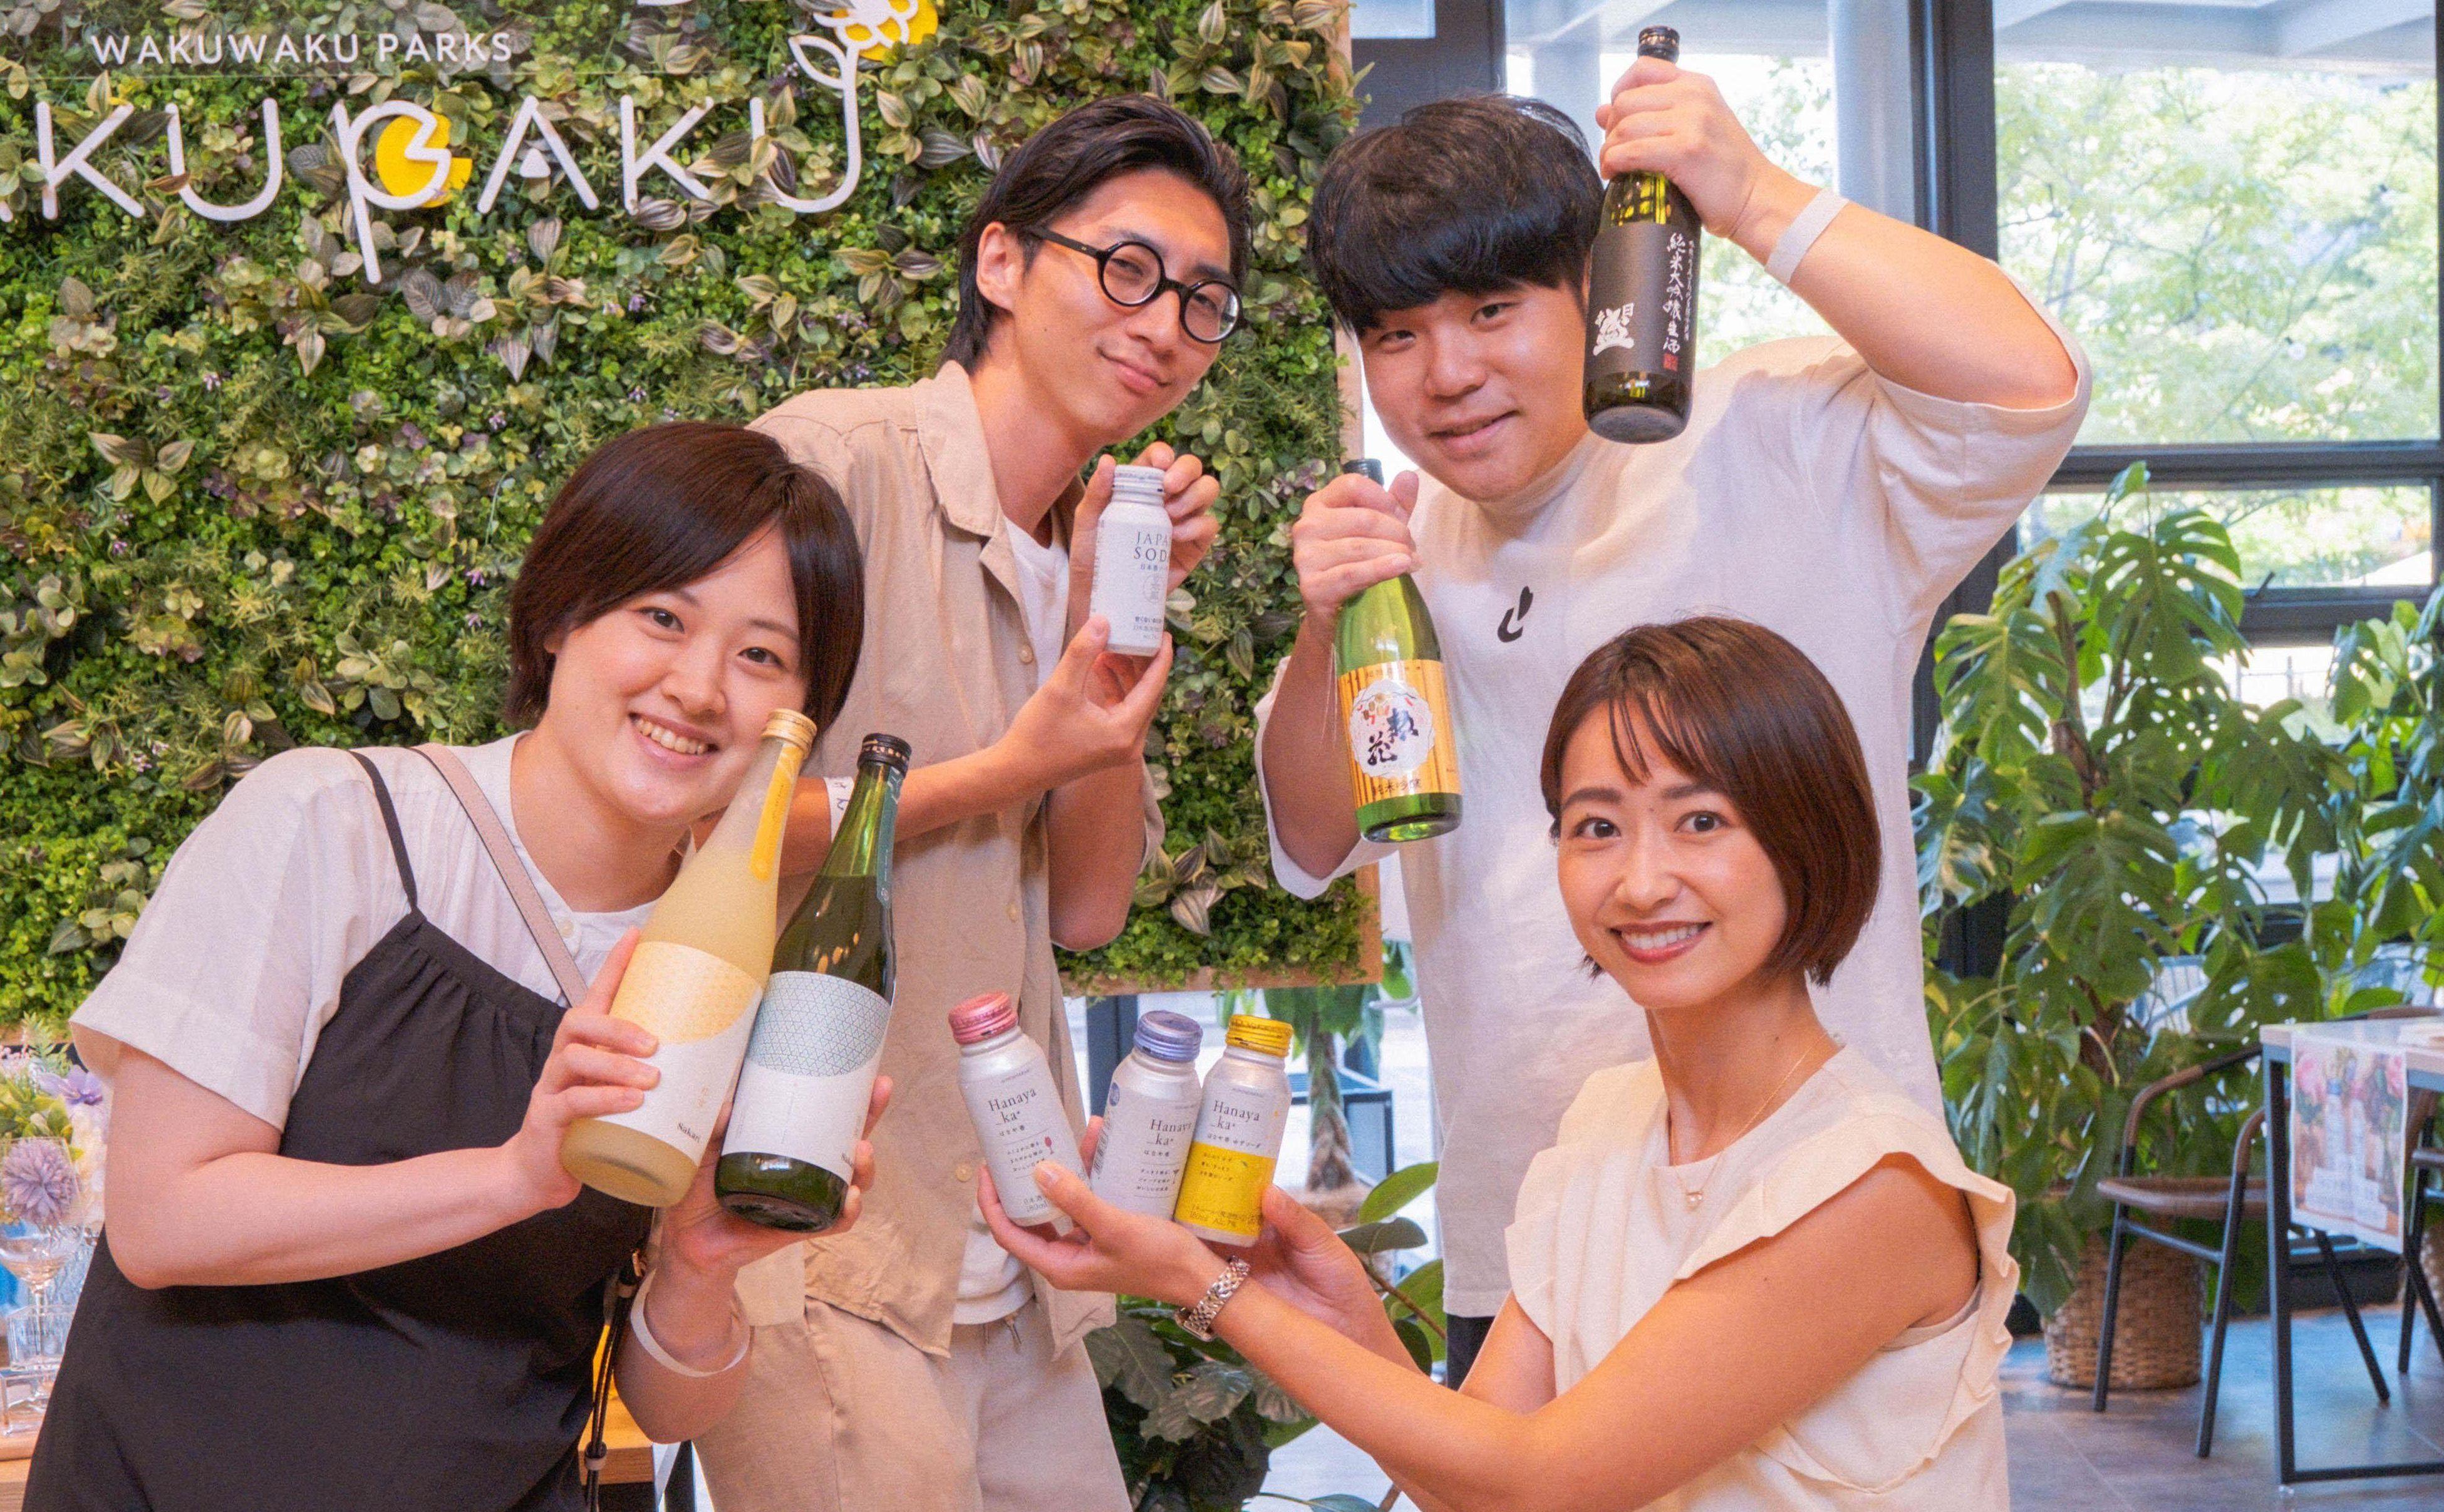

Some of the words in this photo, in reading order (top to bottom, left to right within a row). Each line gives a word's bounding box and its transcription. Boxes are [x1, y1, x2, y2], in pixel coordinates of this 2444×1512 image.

[91, 33, 359, 65] WAKUWAKU
[379, 32, 512, 63] PARKS
[0, 50, 862, 284] KUPAKU
[1134, 531, 1169, 547] JAPA
[1133, 546, 1168, 562] SOD
[988, 1088, 1037, 1112] Hanaya
[1213, 1099, 1260, 1123] Hanaya
